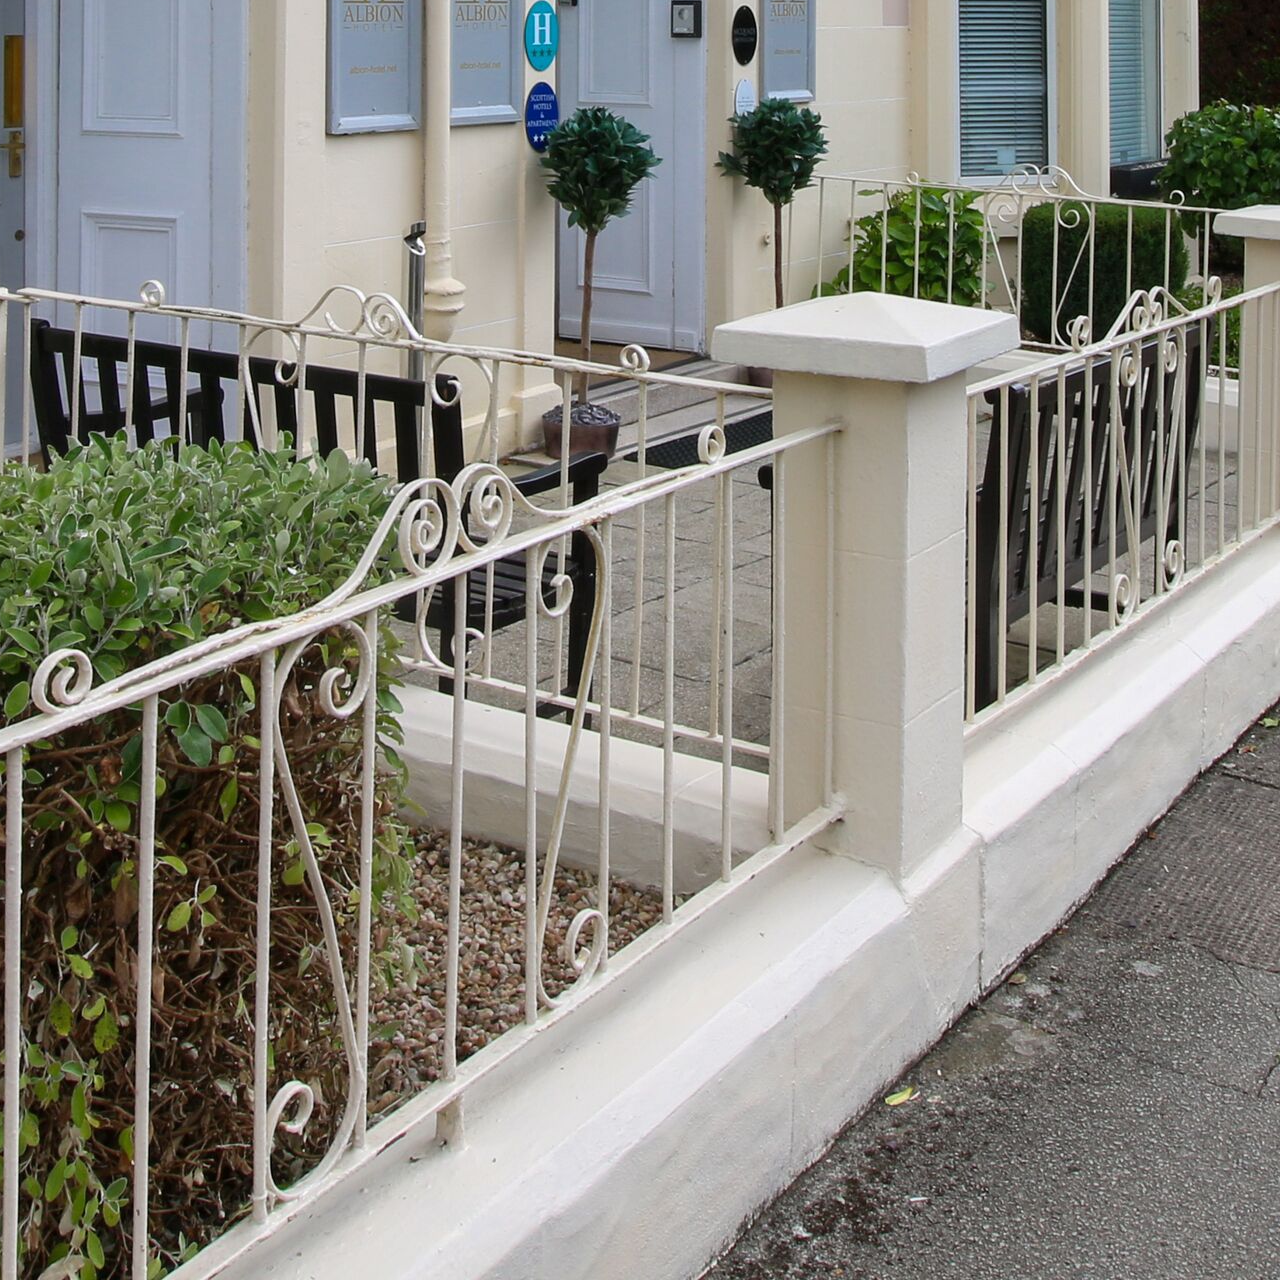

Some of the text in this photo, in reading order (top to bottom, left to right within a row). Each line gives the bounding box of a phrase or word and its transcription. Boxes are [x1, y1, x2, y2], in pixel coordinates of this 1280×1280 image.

[343, 5, 405, 23] ALBION
[455, 4, 508, 21] ALBION
[770, 4, 806, 17] ALBION
[532, 12, 553, 46] H
[530, 94, 555, 102] SCOTTISH
